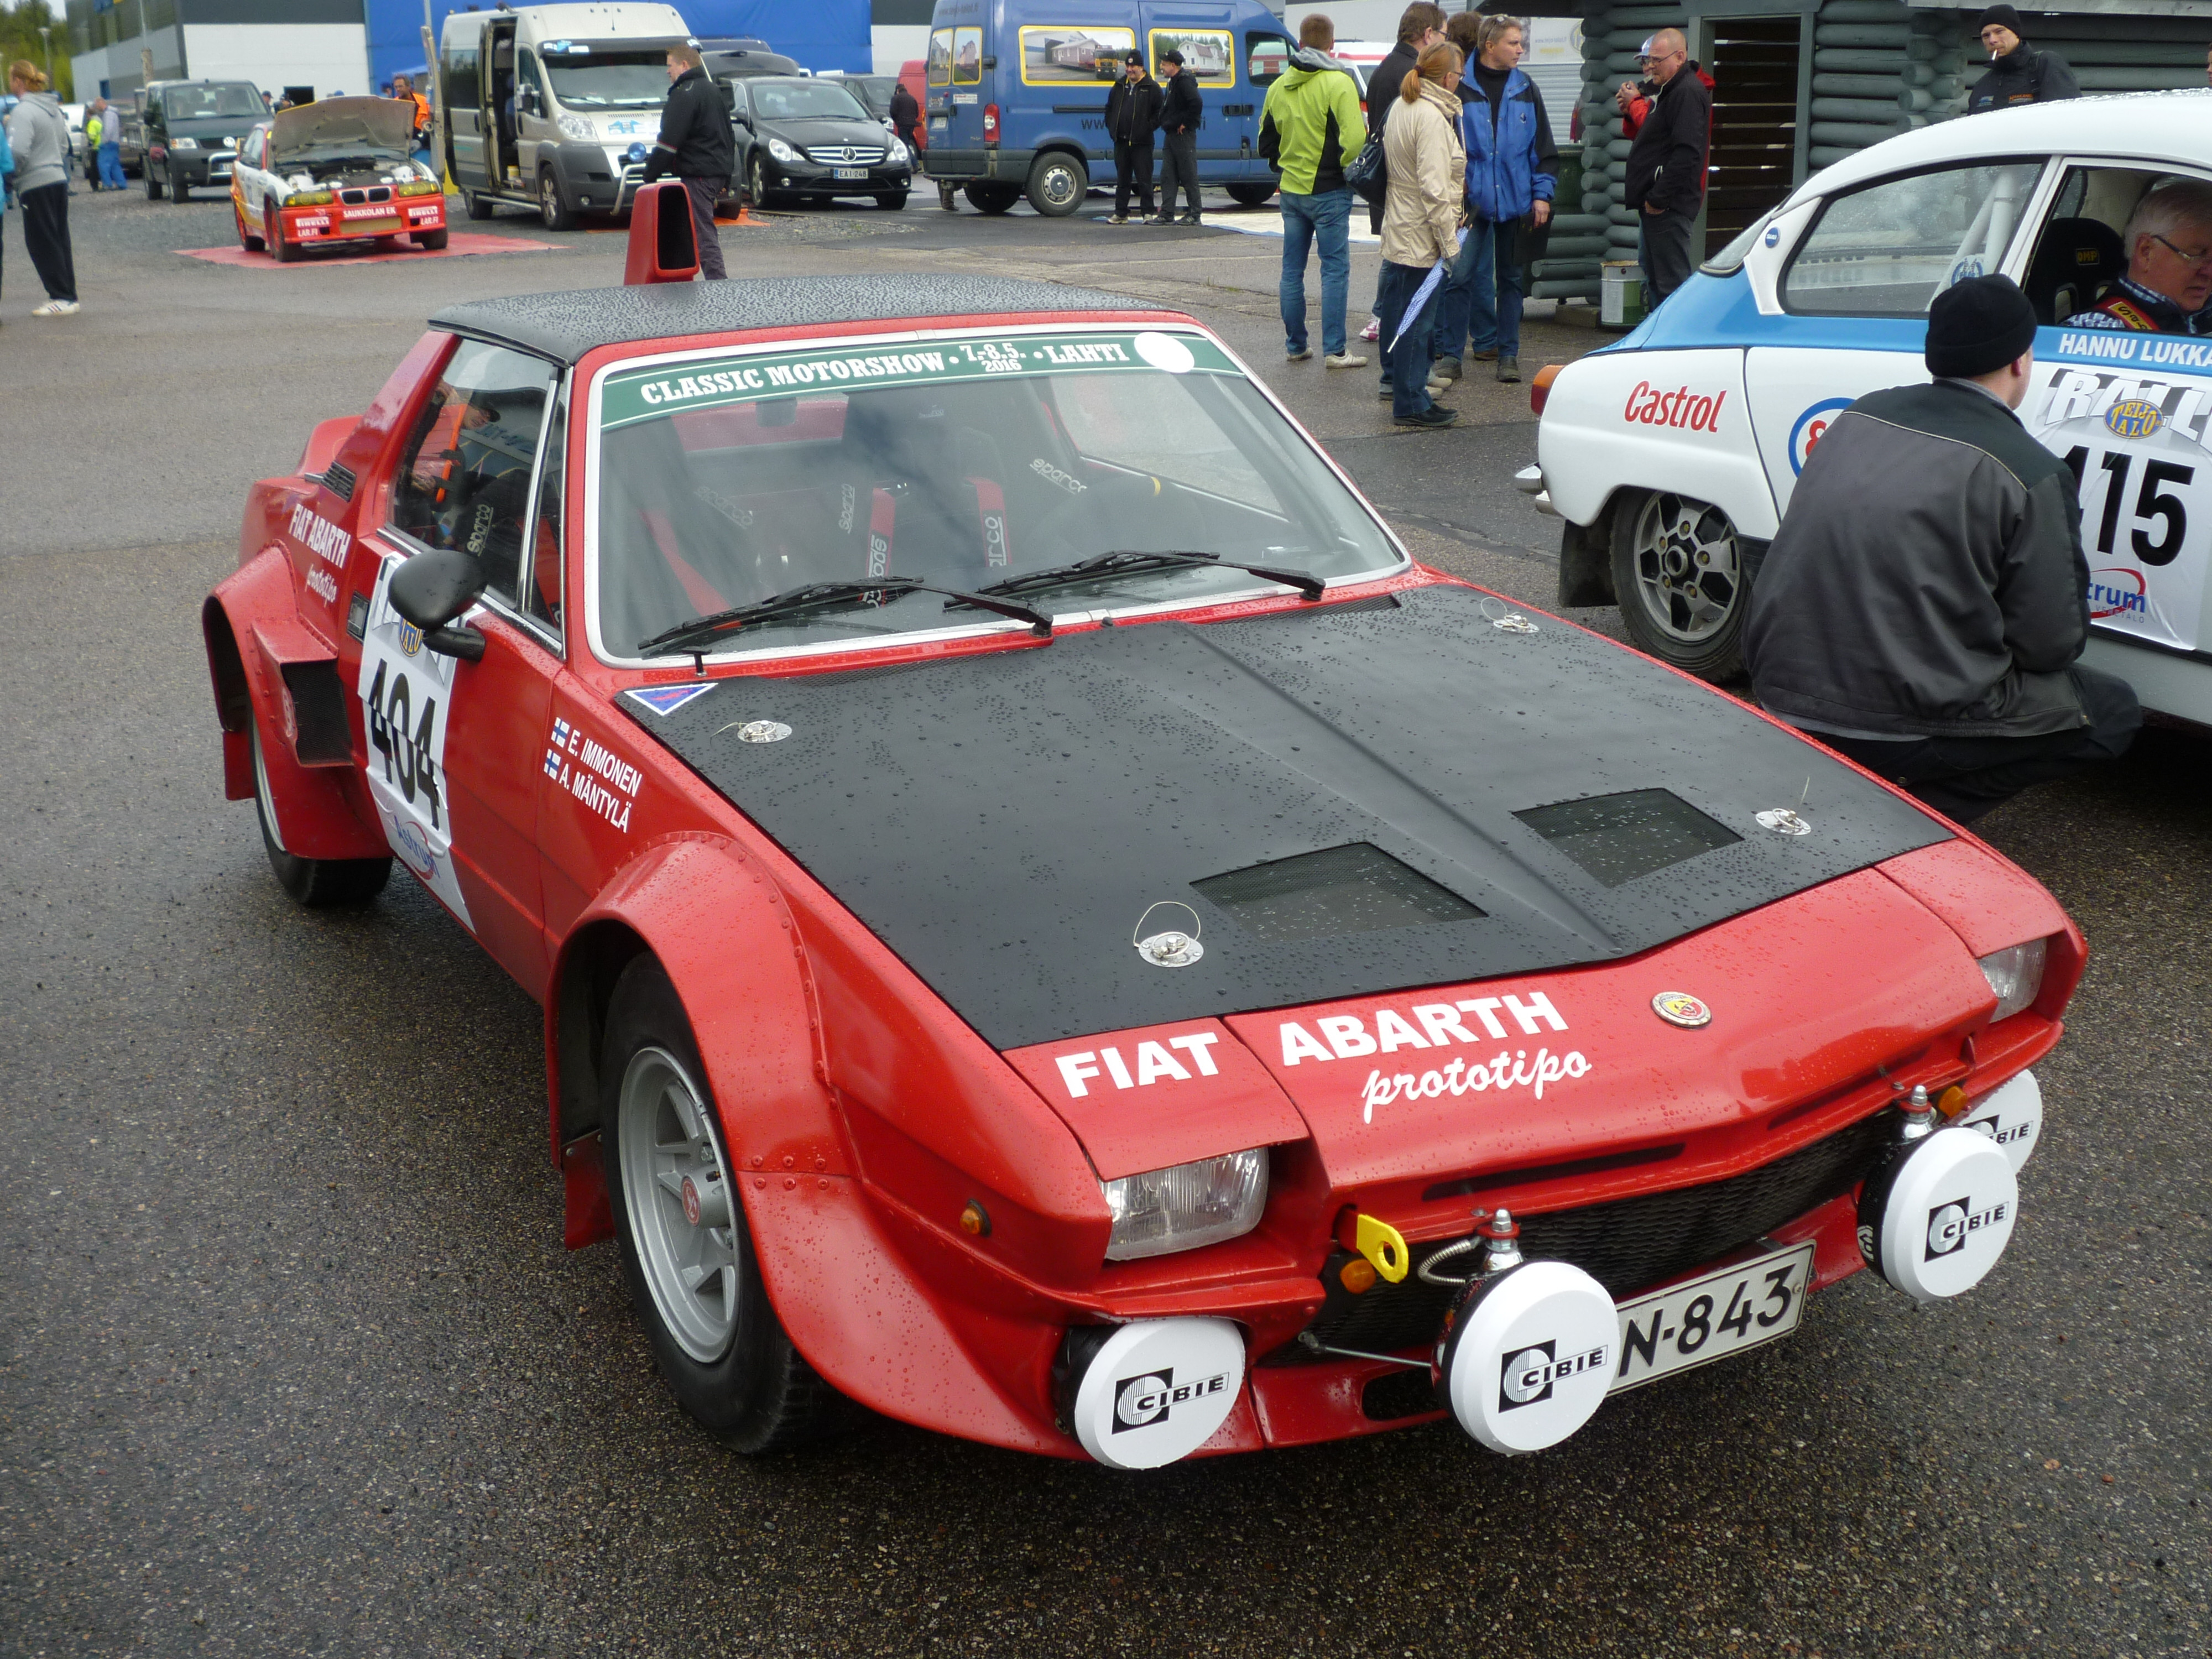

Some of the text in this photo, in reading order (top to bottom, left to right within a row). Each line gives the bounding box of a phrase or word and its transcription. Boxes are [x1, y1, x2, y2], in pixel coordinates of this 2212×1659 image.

[298, 228, 318, 237] LAR.FI
[343, 208, 385, 217] SAUKKOLAN
[420, 216, 439, 225] LAR.FI
[640, 367, 765, 405] CLASSIC
[763, 351, 946, 386] MOTORSHOW
[1042, 343, 1130, 363] LAHTI
[981, 359, 1022, 372] 2016
[2058, 333, 2138, 359] HANNU
[1624, 380, 1727, 433] Castrol
[2044, 371, 2212, 453] RALL
[288, 503, 351, 569] FIAT ABARTH
[2086, 582, 2145, 613] trum
[368, 658, 439, 831] 404
[567, 729, 643, 797] E. IMMONEN
[559, 763, 632, 833] A. MÄNTYLÄ
[1279, 992, 1569, 1066] ABARTH
[1055, 1031, 1219, 1099] FIAT
[1361, 1048, 1592, 1124] prototipo
[1618, 1262, 1797, 1378] N-843
